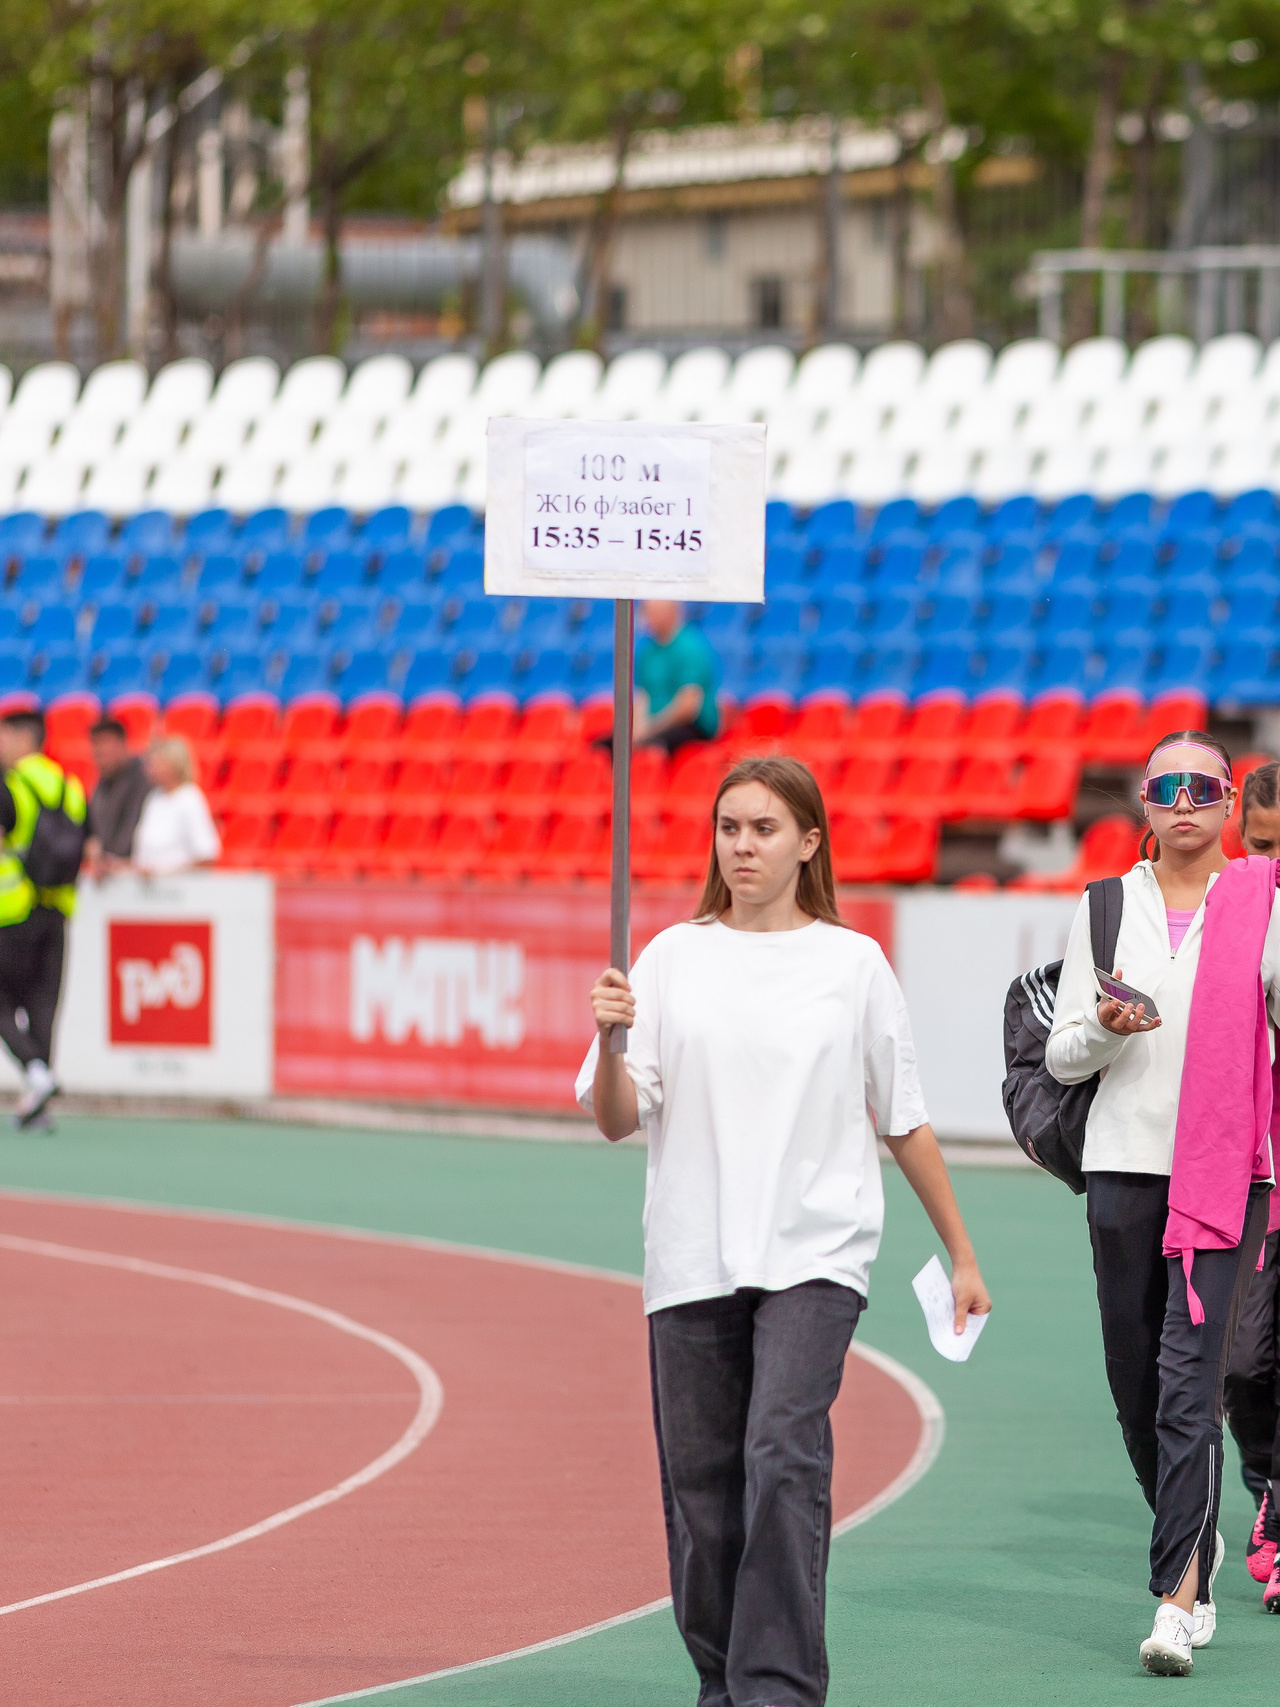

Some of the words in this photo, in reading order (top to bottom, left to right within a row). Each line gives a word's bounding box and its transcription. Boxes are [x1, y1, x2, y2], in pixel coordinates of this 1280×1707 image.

[580, 454, 626, 482] 100
[638, 464, 661, 482] м
[536, 494, 587, 514] Ж16
[594, 495, 676, 520] ф/забег
[686, 498, 693, 516] 1
[531, 527, 601, 550] 15:35
[634, 529, 703, 552] 15:45
